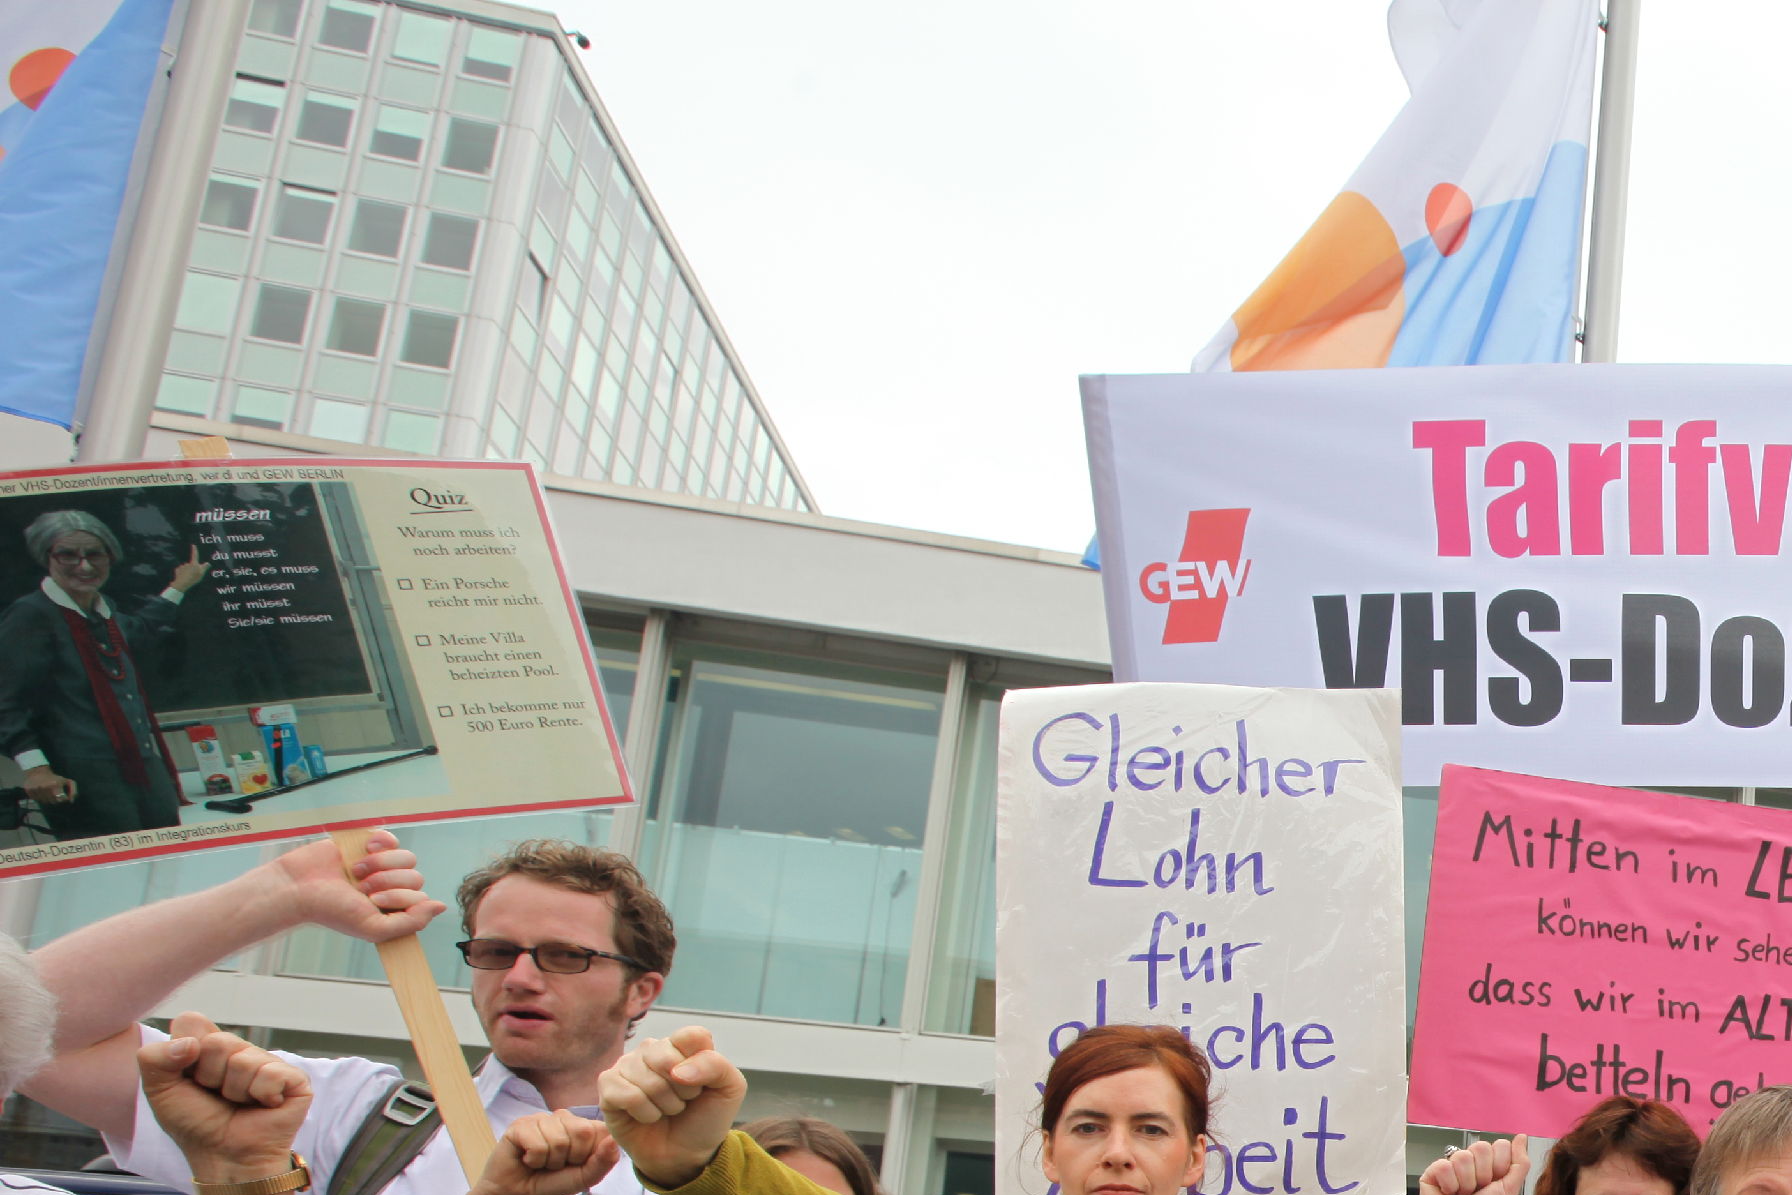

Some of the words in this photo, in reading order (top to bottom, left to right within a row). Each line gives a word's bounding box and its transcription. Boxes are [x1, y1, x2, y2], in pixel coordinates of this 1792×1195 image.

[237, 469, 260, 480] und
[263, 469, 294, 480] GEW
[298, 468, 345, 480] BERLIN
[409, 487, 470, 510] Quiz
[193, 508, 272, 523] müssen
[199, 533, 222, 544] ich
[227, 533, 265, 543] muss
[397, 526, 455, 538] Warum
[459, 528, 496, 538] muss
[499, 527, 520, 538] ich
[212, 550, 230, 561] du
[233, 548, 279, 560] musst
[413, 544, 450, 556] noch
[454, 544, 518, 556] arbeiten?
[260, 565, 277, 575] es
[281, 564, 320, 574] muss
[216, 585, 237, 595] wir
[242, 581, 295, 593] müssen
[421, 577, 451, 590] Ein
[452, 577, 511, 590] Porsche
[1138, 557, 1253, 605] GEW
[222, 602, 241, 611] ihr
[246, 597, 291, 610] müsst
[427, 595, 471, 608] reicht
[474, 594, 500, 607] mir
[502, 593, 544, 607] nicht.
[280, 613, 333, 624] müssen
[439, 634, 488, 646] Meine
[489, 631, 527, 644] Villa
[443, 650, 501, 664] braucht
[503, 650, 543, 662] einen
[448, 668, 521, 681] beheizten
[521, 664, 560, 678] Pool.
[460, 702, 487, 716] Ich
[489, 701, 560, 714] bekomme
[561, 700, 587, 710] nur
[467, 719, 496, 733] 500
[497, 718, 536, 732] Euro
[537, 715, 584, 729] Rente.
[1031, 710, 1368, 799] Gleicher
[109, 835, 135, 851] (83)
[137, 834, 154, 845] im
[155, 819, 252, 843] Integrationskurs
[1087, 800, 1275, 897] Lohn
[1471, 809, 1641, 875] Mitten
[1668, 847, 1719, 888] im
[1536, 896, 1649, 945] können
[1666, 921, 1720, 954] wir
[1127, 909, 1265, 1010] für
[1467, 962, 1553, 1008] dass
[1573, 981, 1636, 1015] wir
[1657, 987, 1701, 1025] im
[1535, 1032, 1692, 1105] betteln
